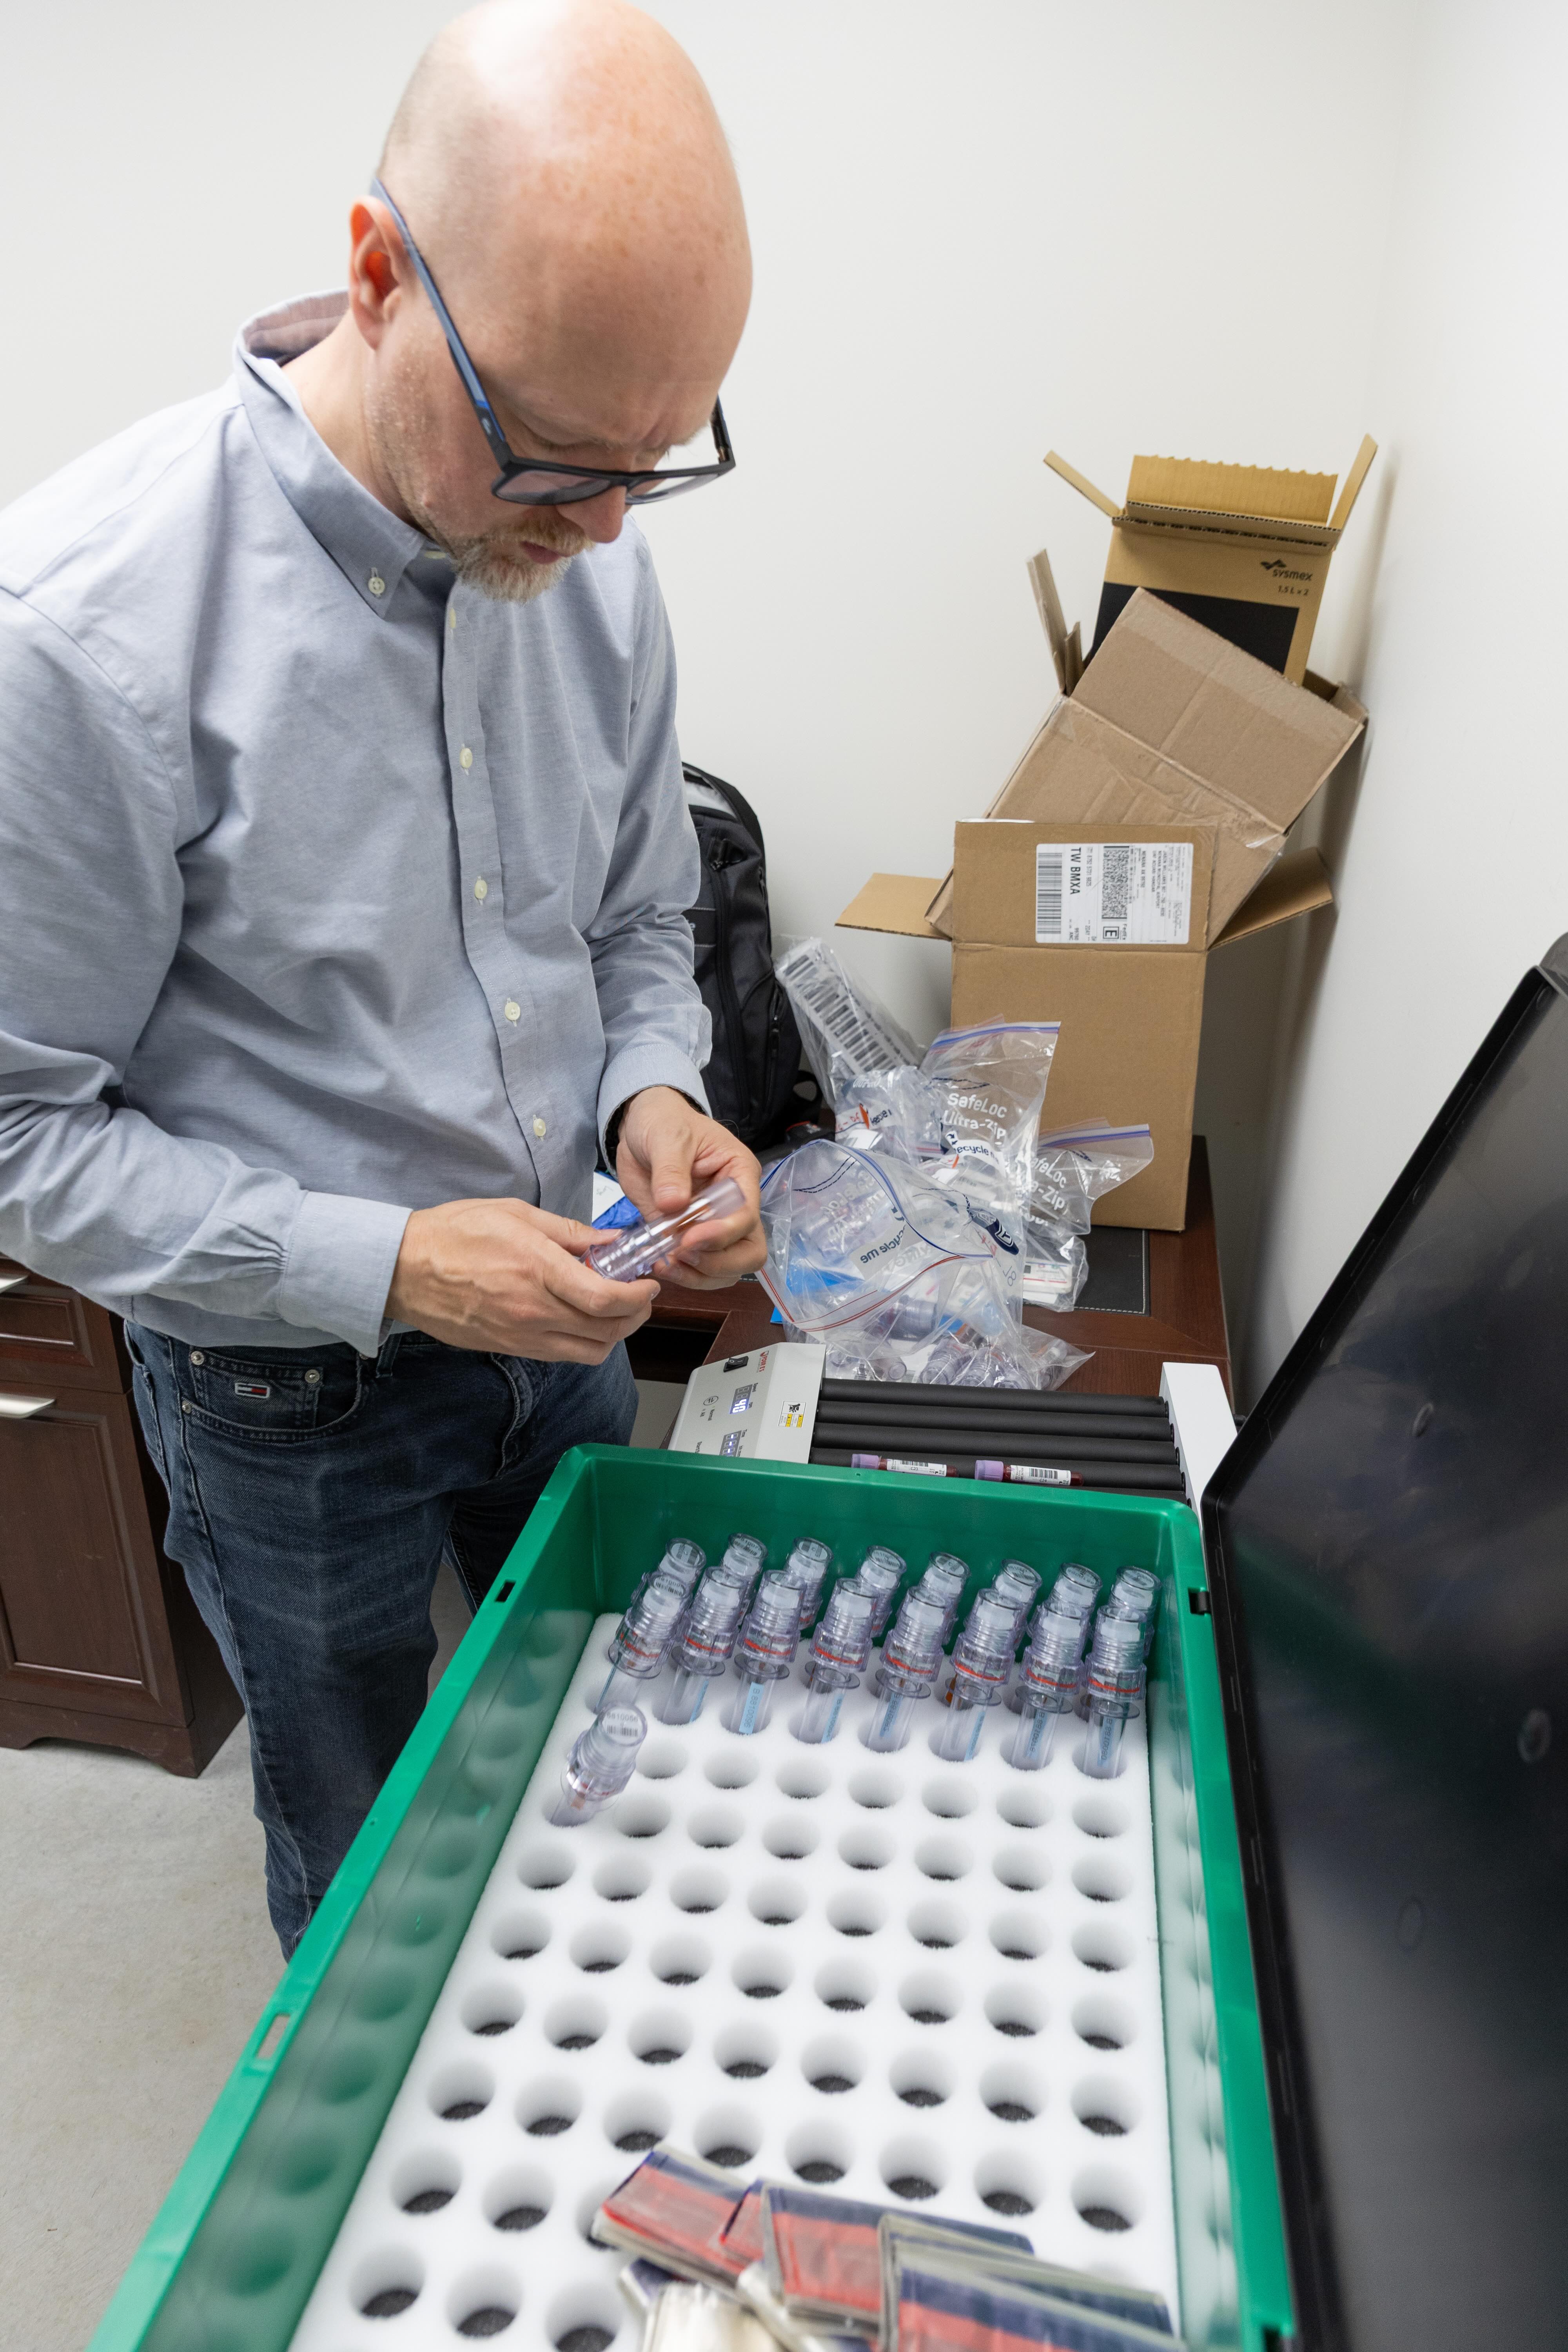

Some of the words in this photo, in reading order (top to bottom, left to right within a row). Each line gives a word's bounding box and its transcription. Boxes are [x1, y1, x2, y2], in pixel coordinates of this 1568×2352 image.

[1272, 569, 1313, 581] sysmex
[1071, 847, 1081, 862] TW
[1070, 867, 1080, 895] BMXA
[947, 1093, 1007, 1118] SafeLoc
[940, 1110, 1007, 1140] Ultra-Zip
[1031, 1158, 1067, 1189] afeLoc
[732, 1398, 747, 1413] 40
[745, 1695, 758, 1728] 8810096
